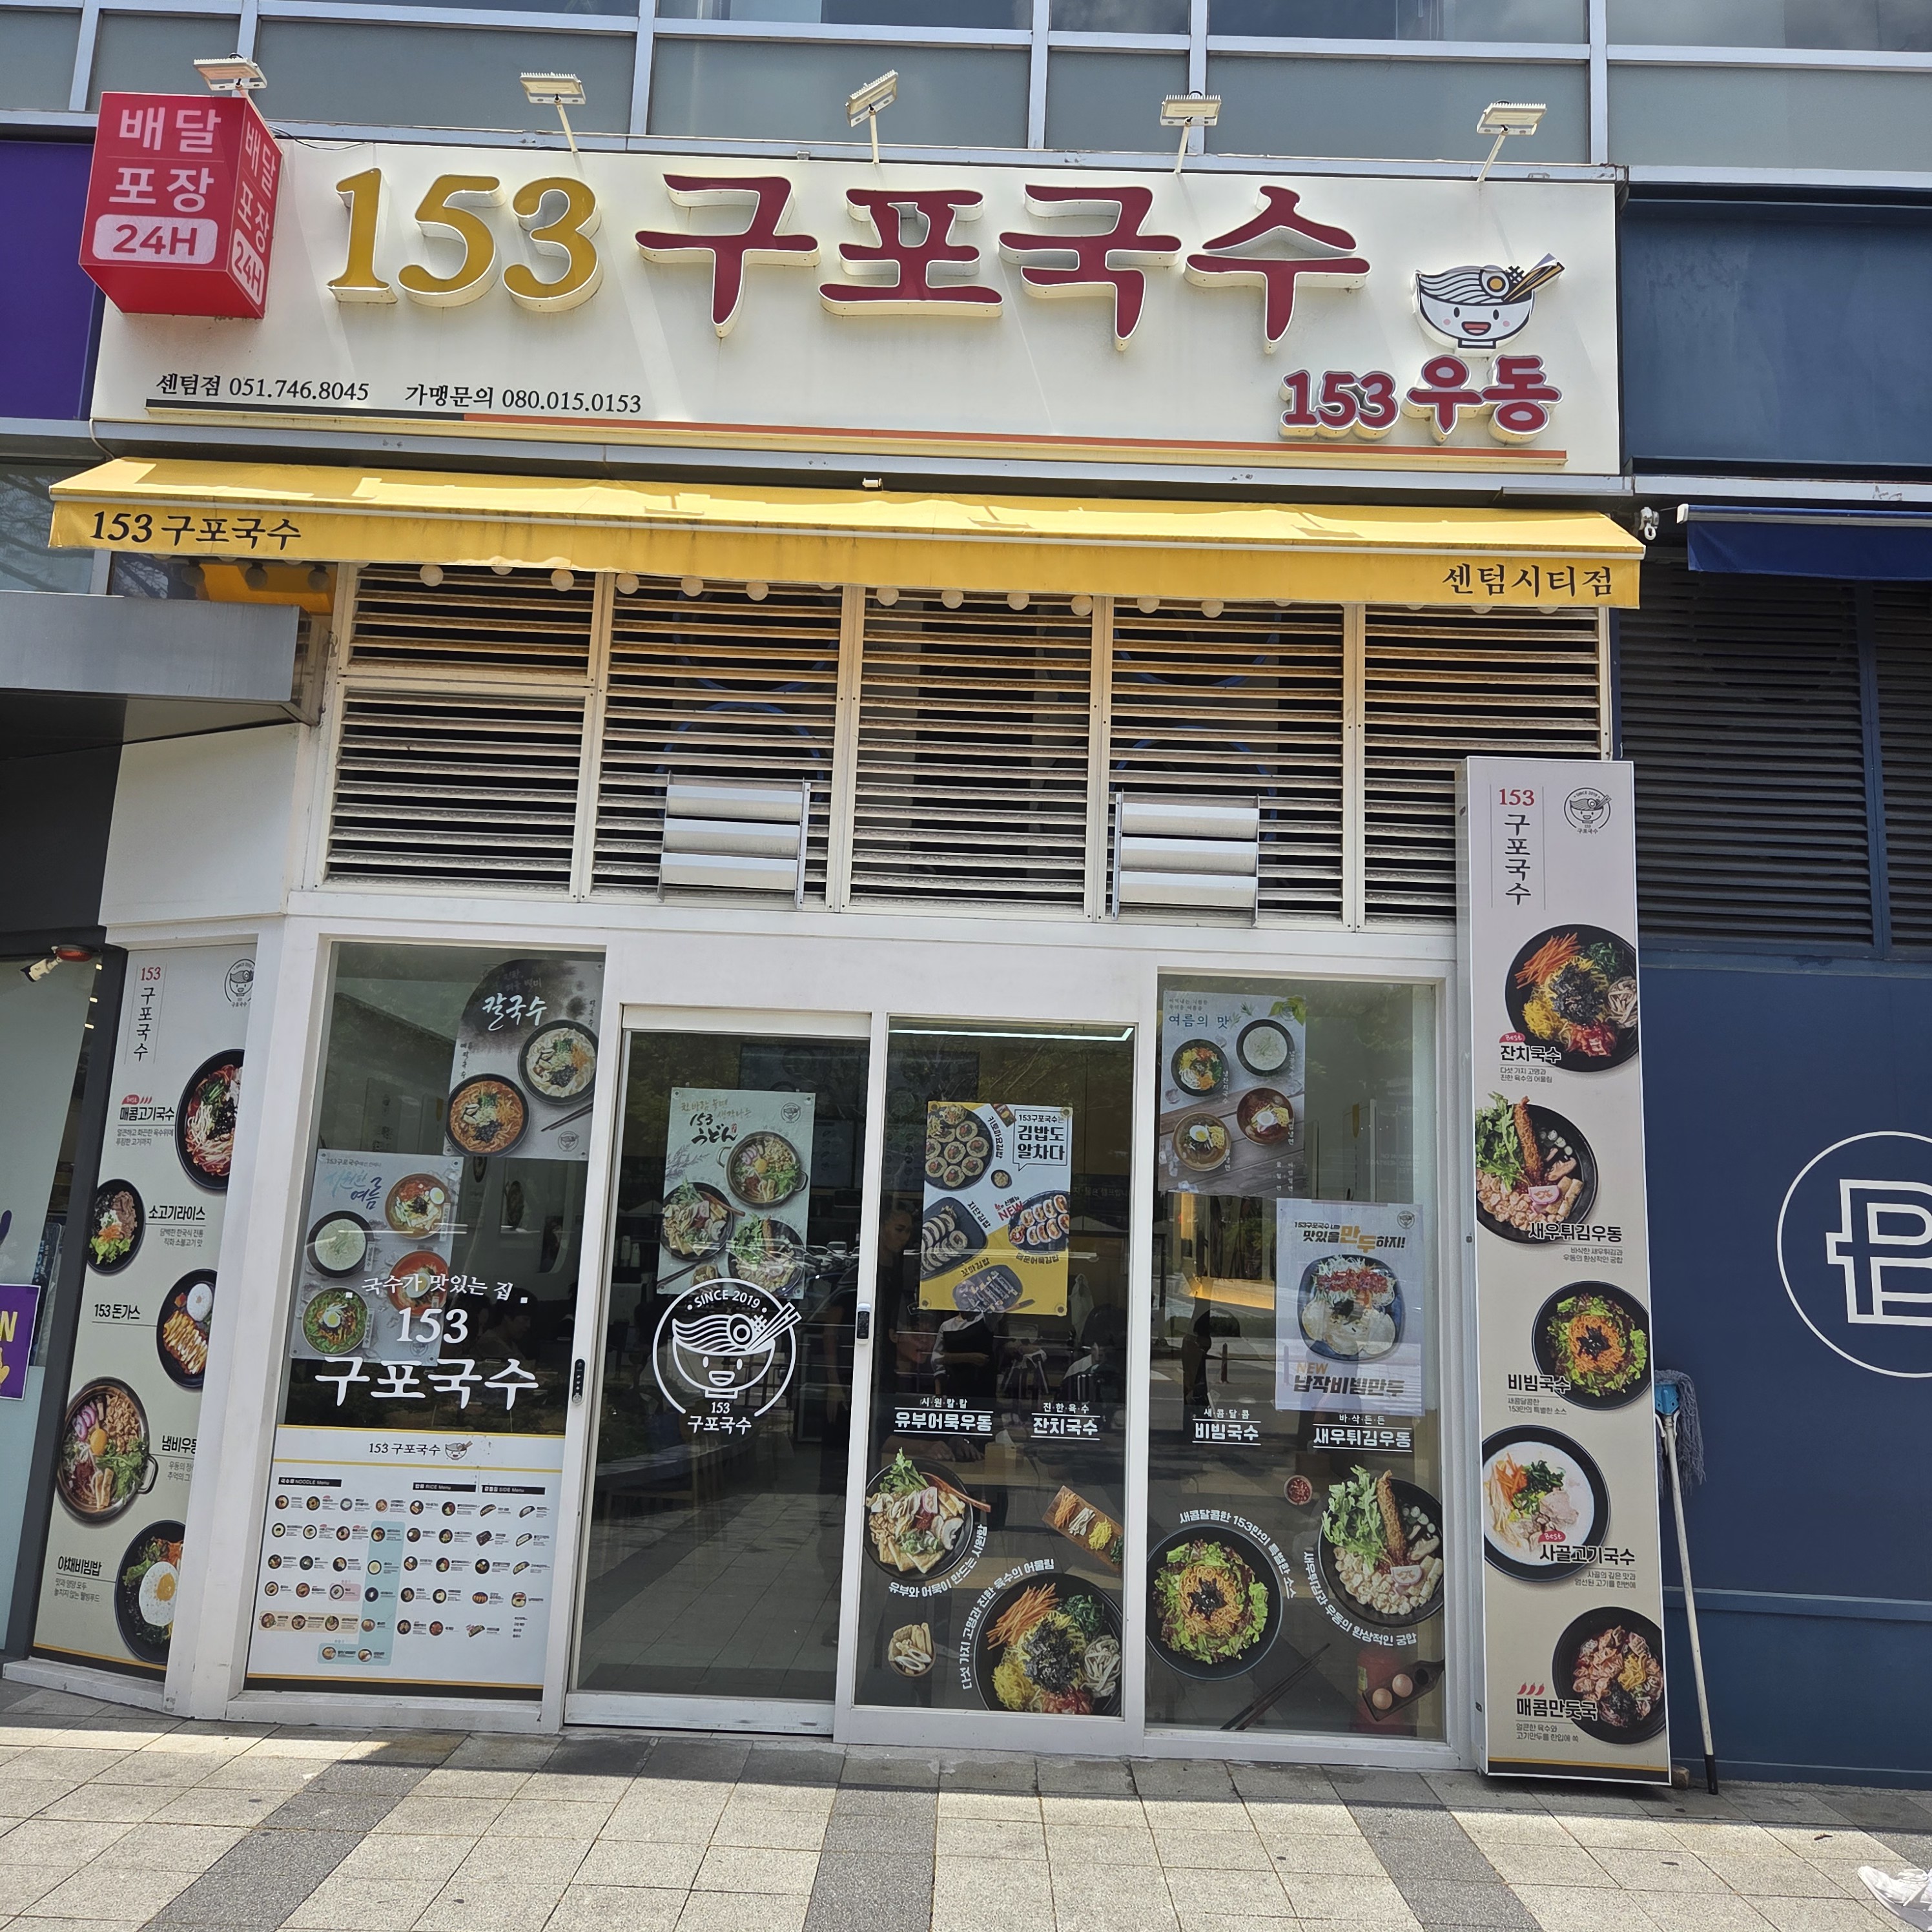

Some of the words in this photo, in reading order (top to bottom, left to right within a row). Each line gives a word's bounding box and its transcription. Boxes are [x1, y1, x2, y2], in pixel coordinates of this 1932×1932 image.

[119, 107, 221, 154] 배달
[245, 119, 276, 193] 배달
[108, 167, 214, 213] 포장
[238, 179, 271, 254] 포장
[112, 223, 198, 257] 24H
[327, 167, 602, 310] 153
[635, 173, 1370, 352] 구포국수
[233, 240, 263, 302] 24H
[156, 373, 221, 398] 센텀점
[229, 377, 369, 402] 051.746.8045
[405, 383, 494, 409] 가맹문의
[502, 388, 642, 414] 080.015.0153
[1442, 562, 1612, 598] 센텀시티점
[1499, 788, 1535, 807] 153
[1504, 814, 1532, 906] 구포국수
[141, 967, 161, 981] 153
[482, 992, 548, 1031] 칼국수
[1169, 1013, 1208, 1027] 여름의
[1217, 1015, 1229, 1029] 맛
[133, 987, 156, 1062] 구포국수
[1501, 1045, 1561, 1063] 잔치국수
[119, 1106, 175, 1121] 매콤고기국수
[690, 1112, 714, 1126] 153
[691, 1123, 738, 1146] うどん
[1017, 1125, 1065, 1142] 김밥도
[1017, 1143, 1065, 1160] 알차다
[350, 1177, 382, 1210] 여름
[149, 1205, 205, 1220] 소고기라이스
[998, 1200, 1023, 1221] NEW
[1530, 1222, 1622, 1242] 새우튀김우동
[362, 1275, 424, 1296] 국수가
[429, 1273, 488, 1296] 맛있는
[493, 1281, 513, 1300] 집
[694, 1290, 729, 1308] SINCE
[732, 1290, 761, 1309] 2019
[94, 1304, 110, 1317] 153
[112, 1304, 141, 1320] 돈가스
[396, 1308, 469, 1344] 153
[1296, 1362, 1329, 1375] NEW
[314, 1355, 540, 1410] 구포국수
[1293, 1375, 1405, 1397] 납작비빔만두
[1508, 1374, 1571, 1393] 비빔국수
[712, 1402, 730, 1414] 153
[687, 1415, 752, 1435] 구포국수
[894, 1412, 992, 1432] 유부어묵우동
[1033, 1417, 1098, 1435] 잔치국수
[1195, 1423, 1259, 1441] 비빔국수
[1313, 1428, 1412, 1448] 새우튀김우동
[369, 1443, 389, 1453] 153
[391, 1443, 441, 1456] 구포국수
[1545, 1532, 1563, 1540] Best
[889, 1581, 920, 1598] 유부와
[921, 1579, 952, 1598] 어묵이
[951, 1557, 978, 1585] 만드는
[973, 1524, 988, 1558] 시원함
[1180, 1509, 1232, 1524] 새콤달콤한
[1233, 1515, 1271, 1547] 153만의
[1268, 1542, 1291, 1576] 특별한
[1283, 1577, 1297, 1599] 소스
[1539, 1544, 1636, 1566] 사골고기국수
[57, 1556, 102, 1576] 야채비빔밥
[1024, 1558, 1055, 1575] 어울림
[994, 1566, 1023, 1590] 육수의
[977, 1587, 996, 1608] 진한
[1303, 1551, 1329, 1607] 새우튀김과
[1324, 1604, 1353, 1633] 우동의
[1352, 1626, 1394, 1647] 환상적인
[1395, 1632, 1417, 1645] 궁합
[962, 1607, 982, 1640] 고명과
[960, 1641, 971, 1665] 가지
[960, 1667, 972, 1690] 다섯
[1517, 1698, 1598, 1720] 매콤만둣국
